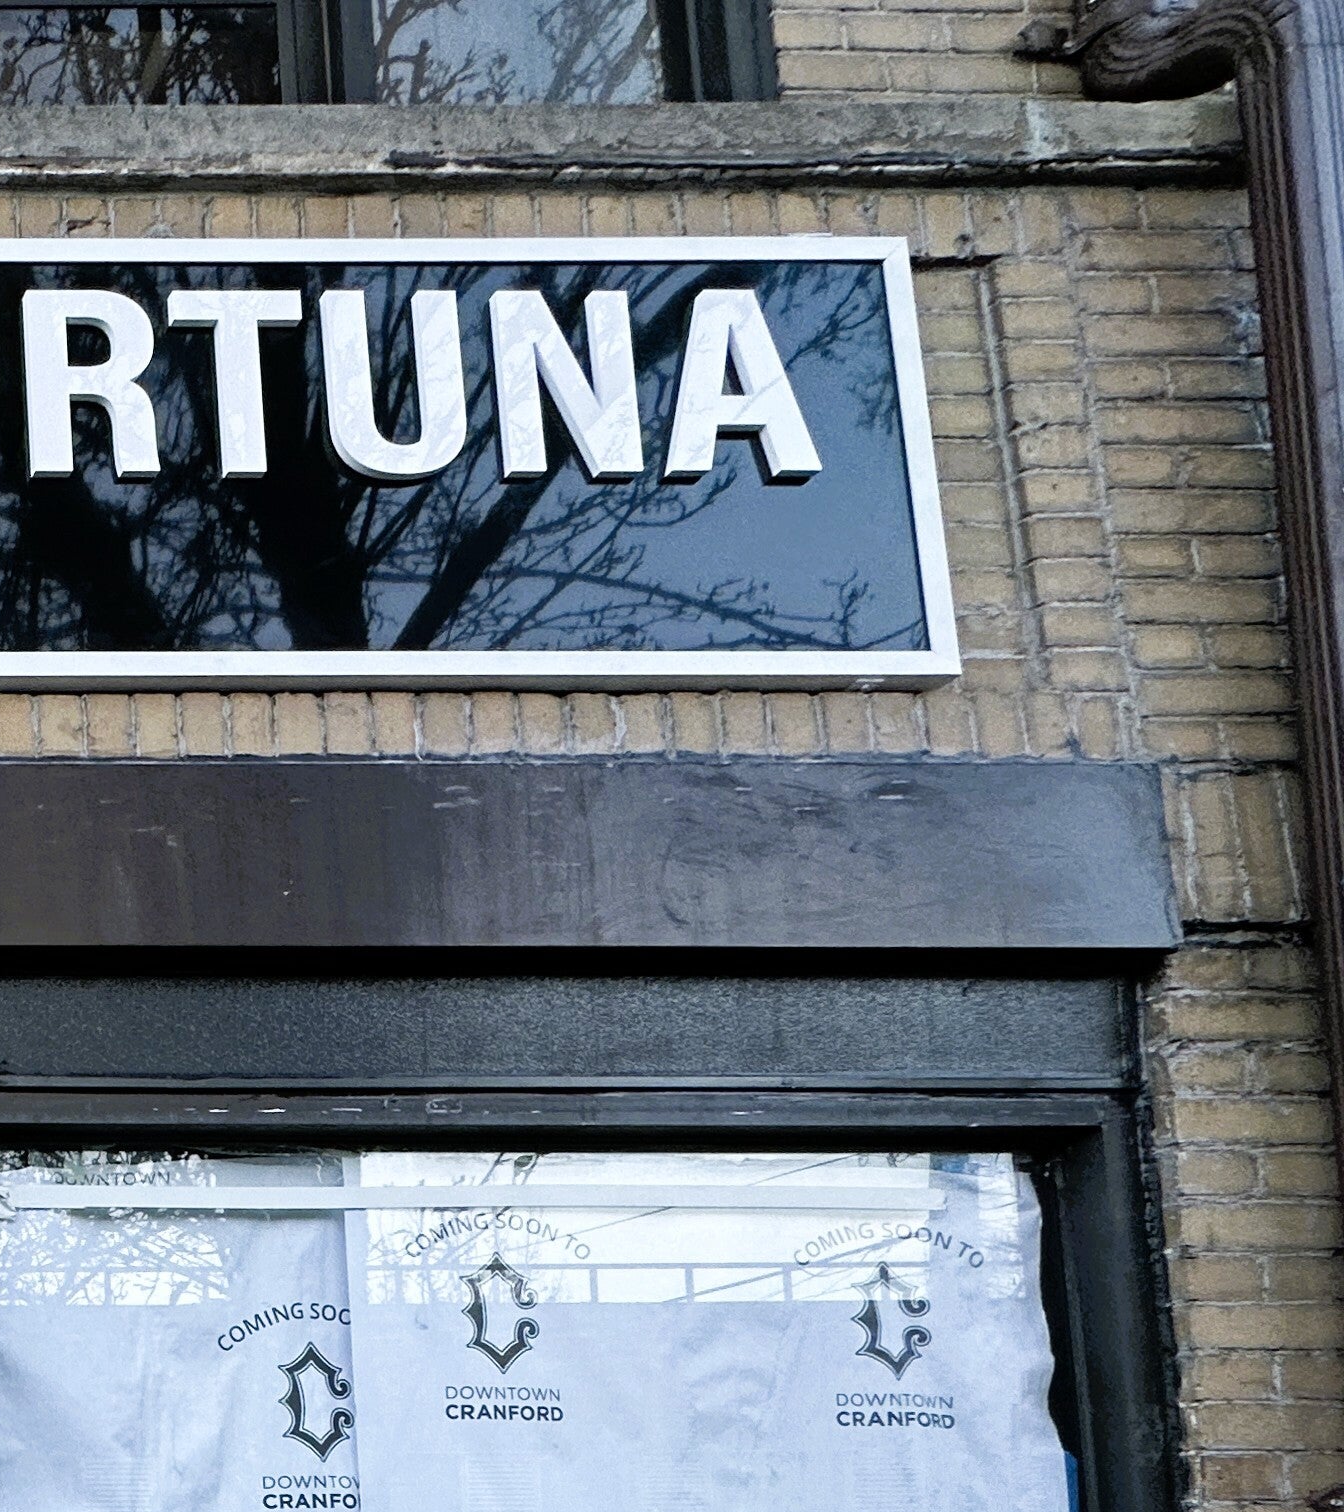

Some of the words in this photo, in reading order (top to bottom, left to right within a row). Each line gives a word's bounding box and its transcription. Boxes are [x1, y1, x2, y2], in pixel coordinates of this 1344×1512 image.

[404, 1213, 489, 1259] COMING
[493, 1213, 560, 1244] SOON
[562, 1234, 592, 1261] TO
[792, 1223, 876, 1267] COMING
[880, 1222, 954, 1255] SOON
[957, 1241, 985, 1268] TO
[217, 1302, 304, 1351] COMING
[445, 1387, 561, 1401] DOWNTOWN
[836, 1393, 953, 1410] DOWNTOWN
[445, 1404, 563, 1423] CRANFORD
[836, 1410, 955, 1429] CRANFORD
